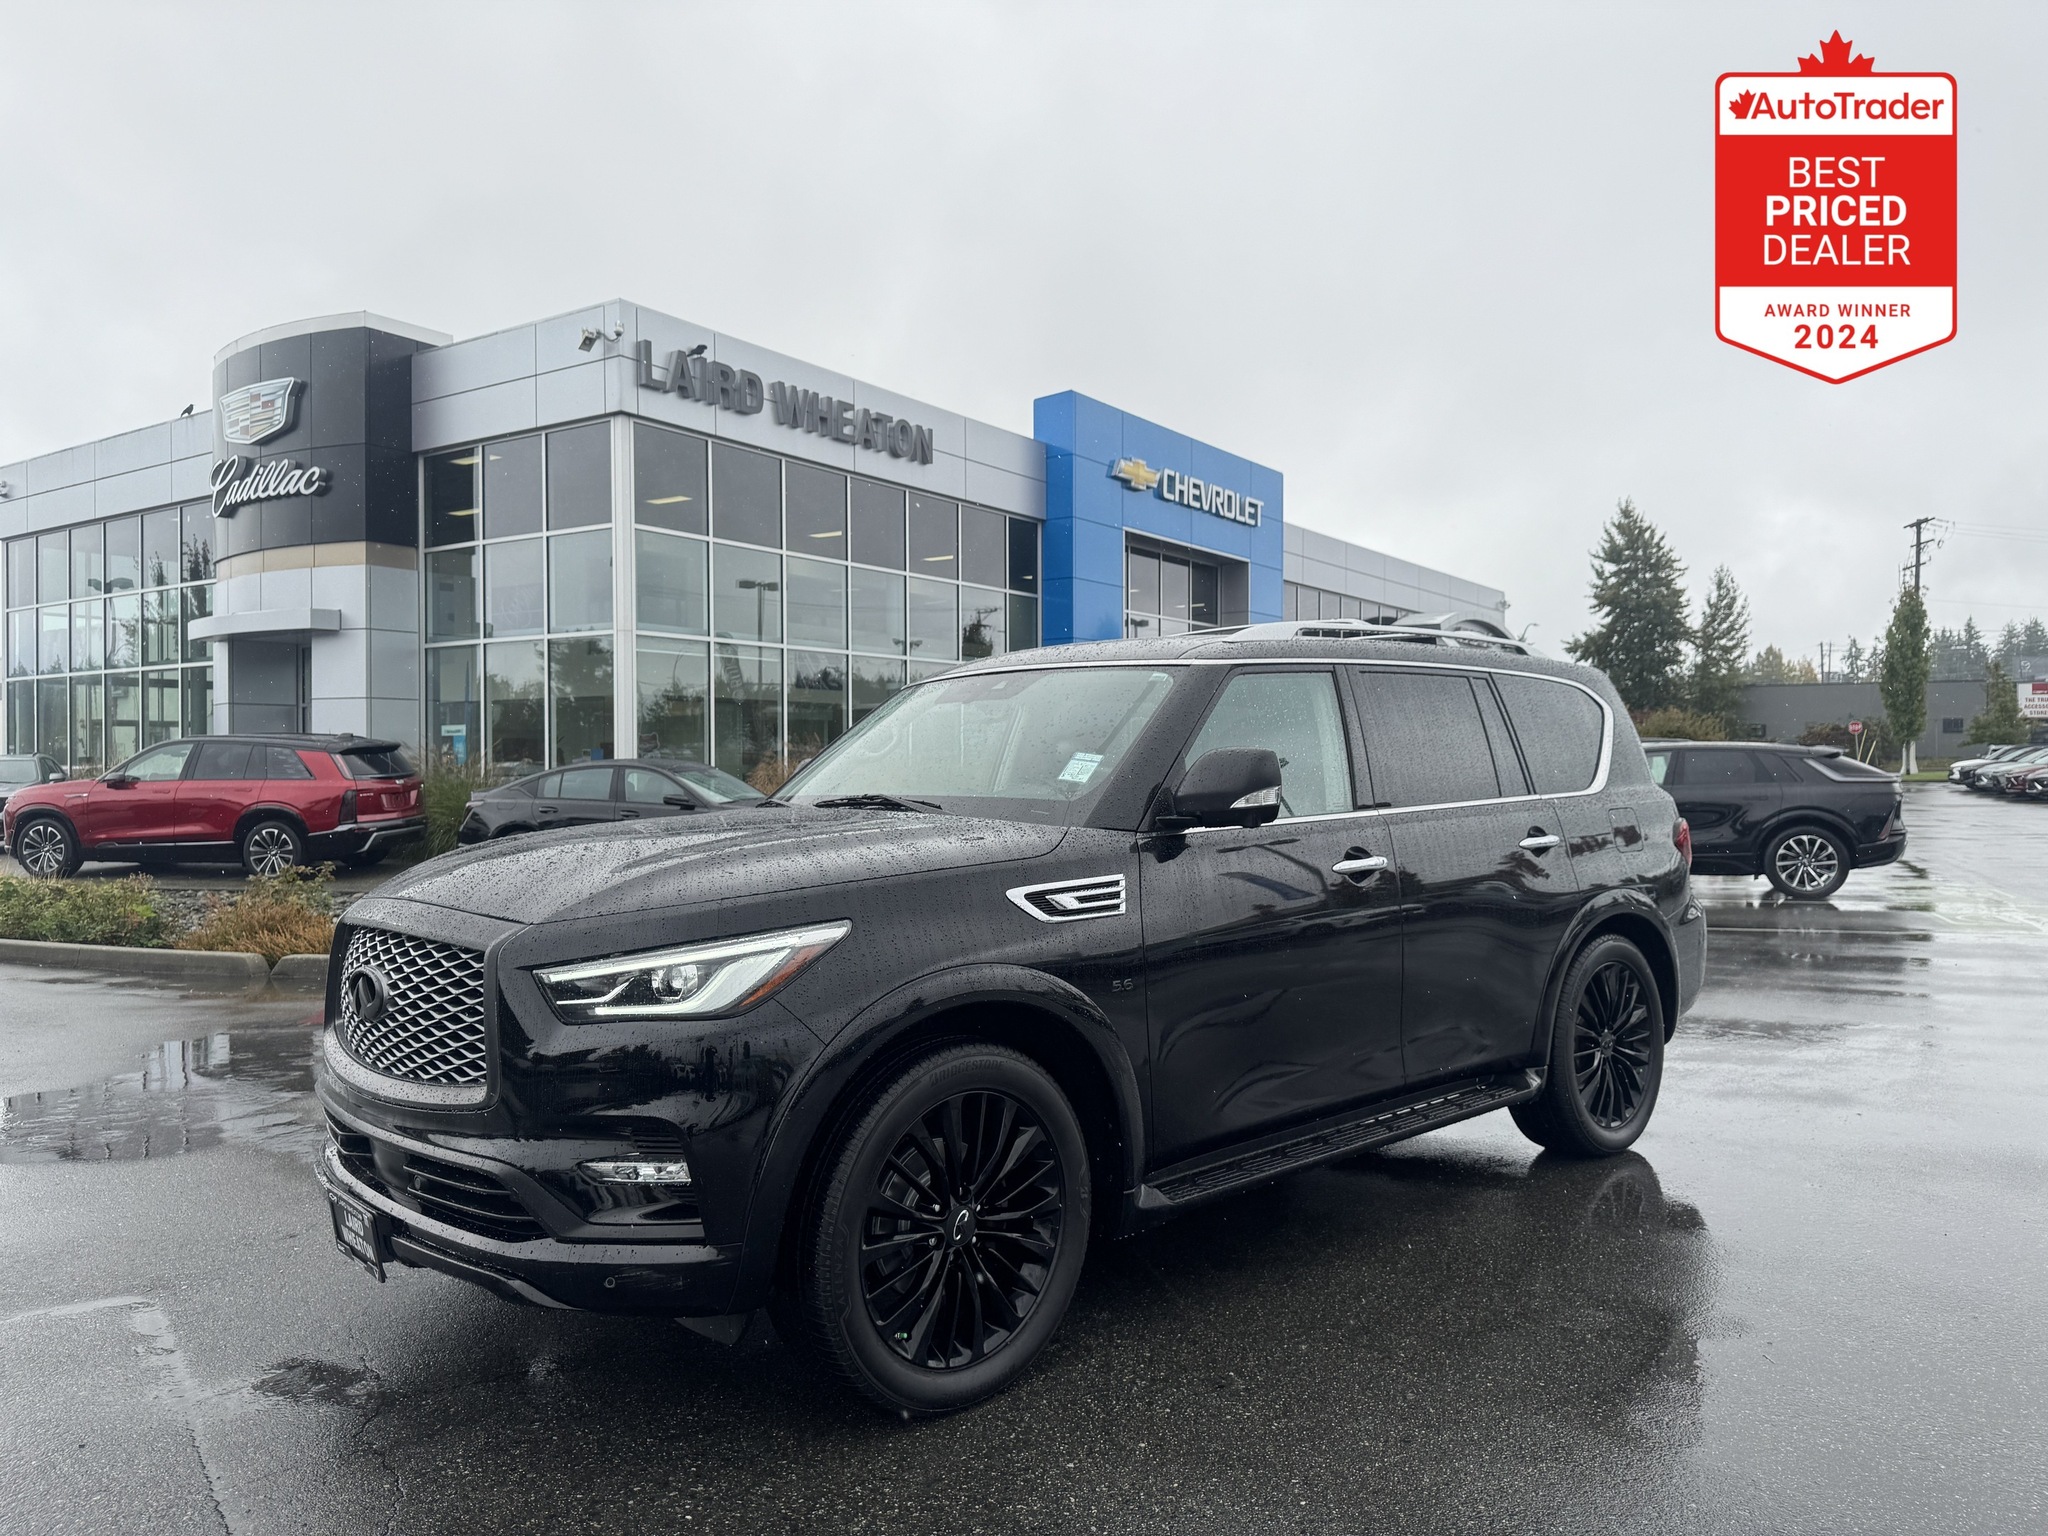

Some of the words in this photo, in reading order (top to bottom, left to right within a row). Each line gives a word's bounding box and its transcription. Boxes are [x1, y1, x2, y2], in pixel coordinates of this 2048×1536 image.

[636, 339, 764, 414] LAIRD
[771, 381, 933, 465] WHEATON
[209, 454, 324, 518] Cadillac
[1162, 467, 1265, 527] CHEVROLET
[1112, 978, 1134, 992] 5.6
